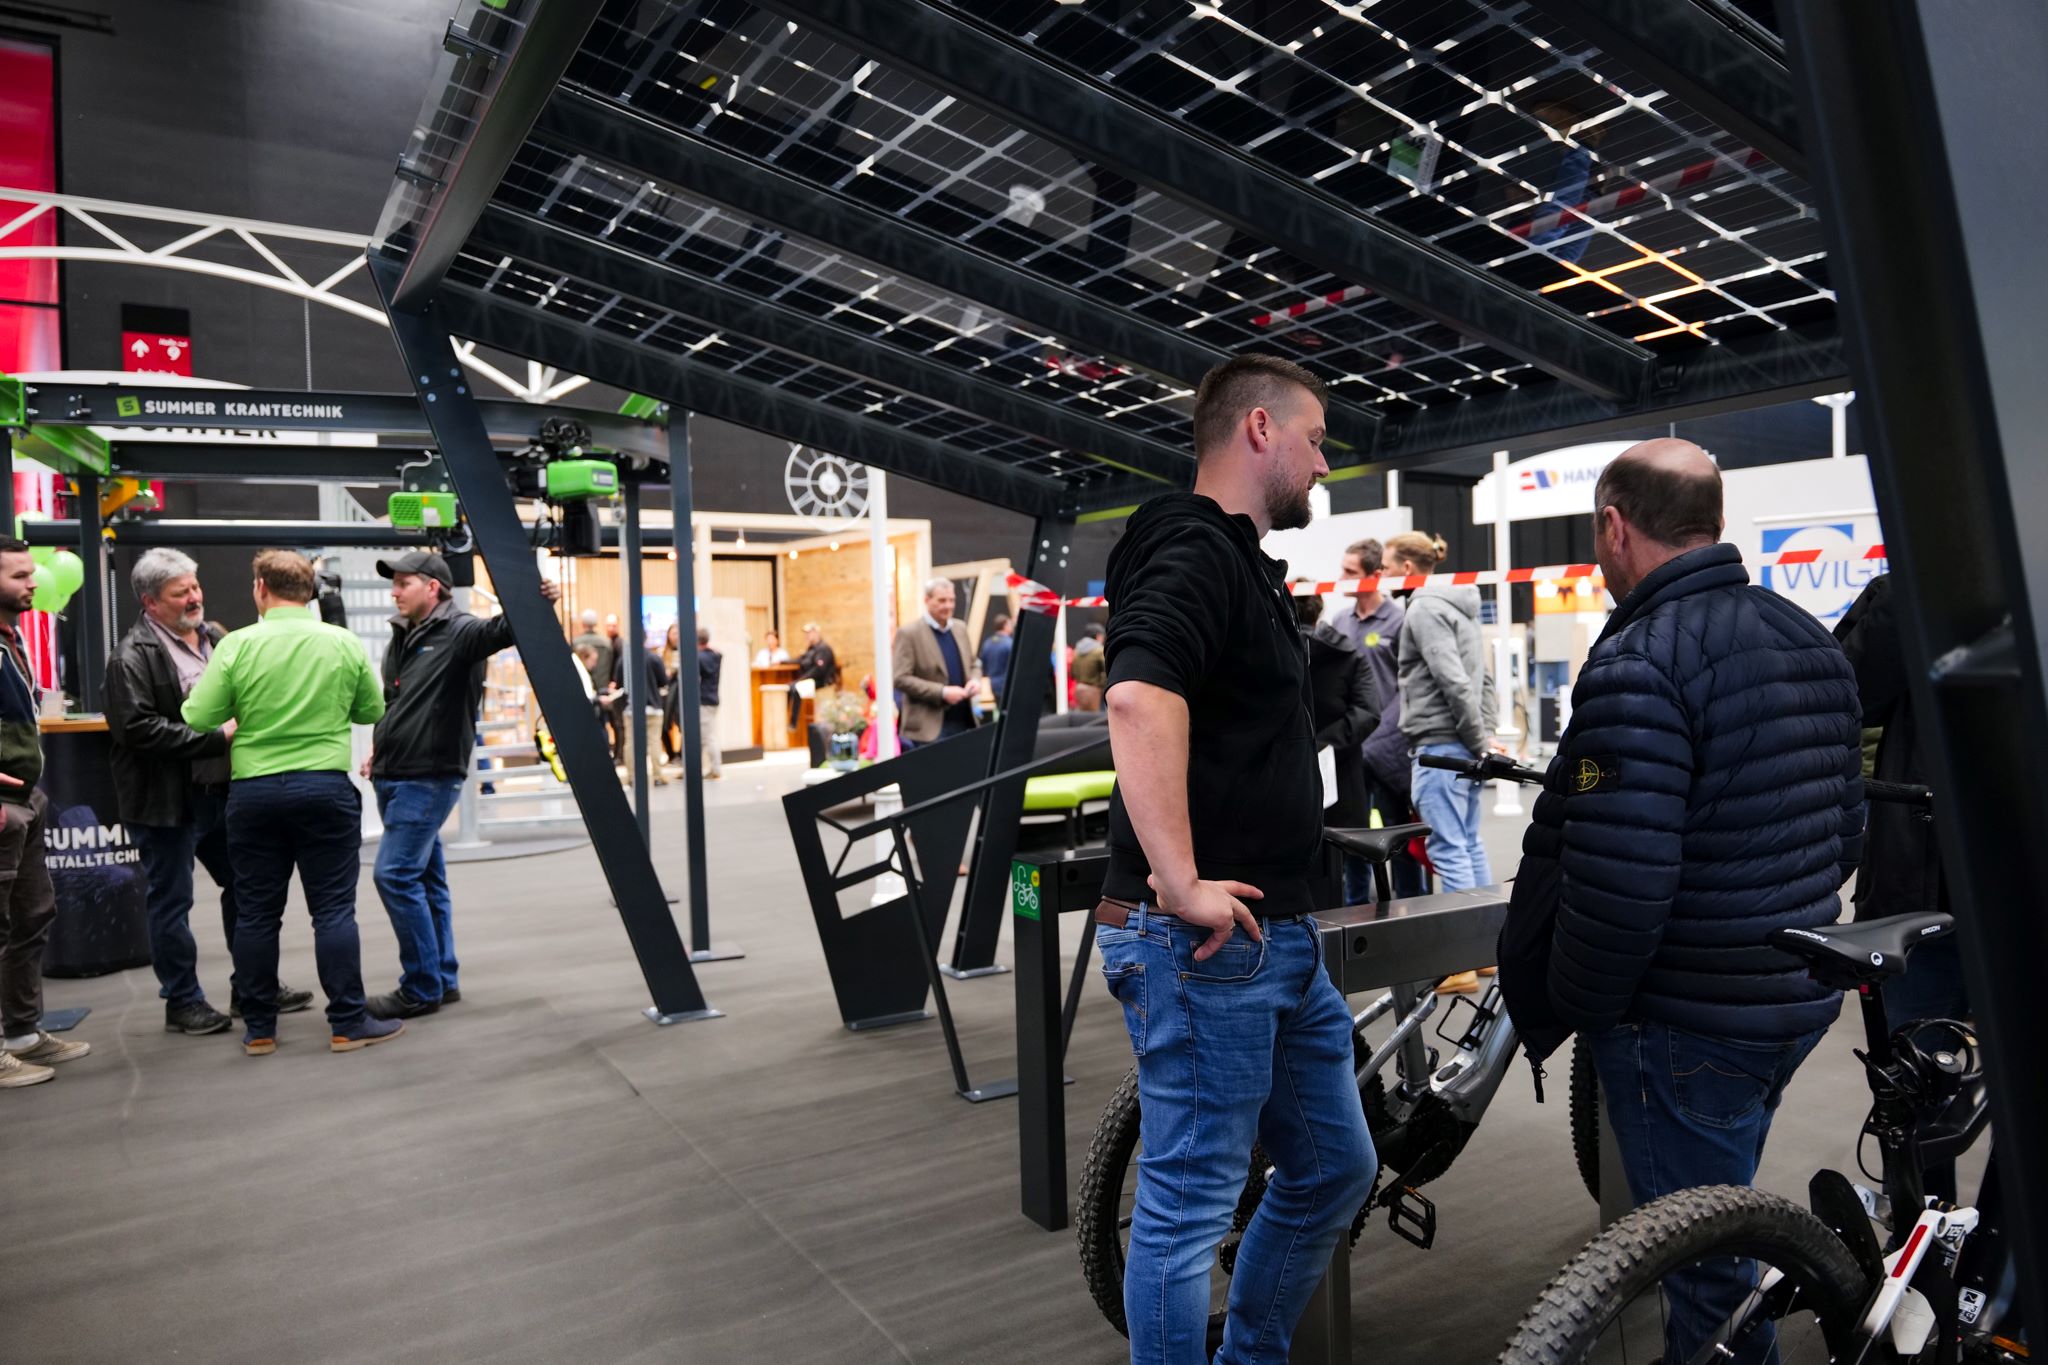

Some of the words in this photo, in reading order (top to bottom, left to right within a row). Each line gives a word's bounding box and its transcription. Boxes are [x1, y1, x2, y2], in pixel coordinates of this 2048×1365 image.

[167, 346, 181, 360] 9
[145, 400, 216, 415] SUMMER
[225, 402, 343, 418] KRANTECHNIK
[1784, 928, 1828, 942] ERGON
[1921, 925, 1940, 935] ERGON
